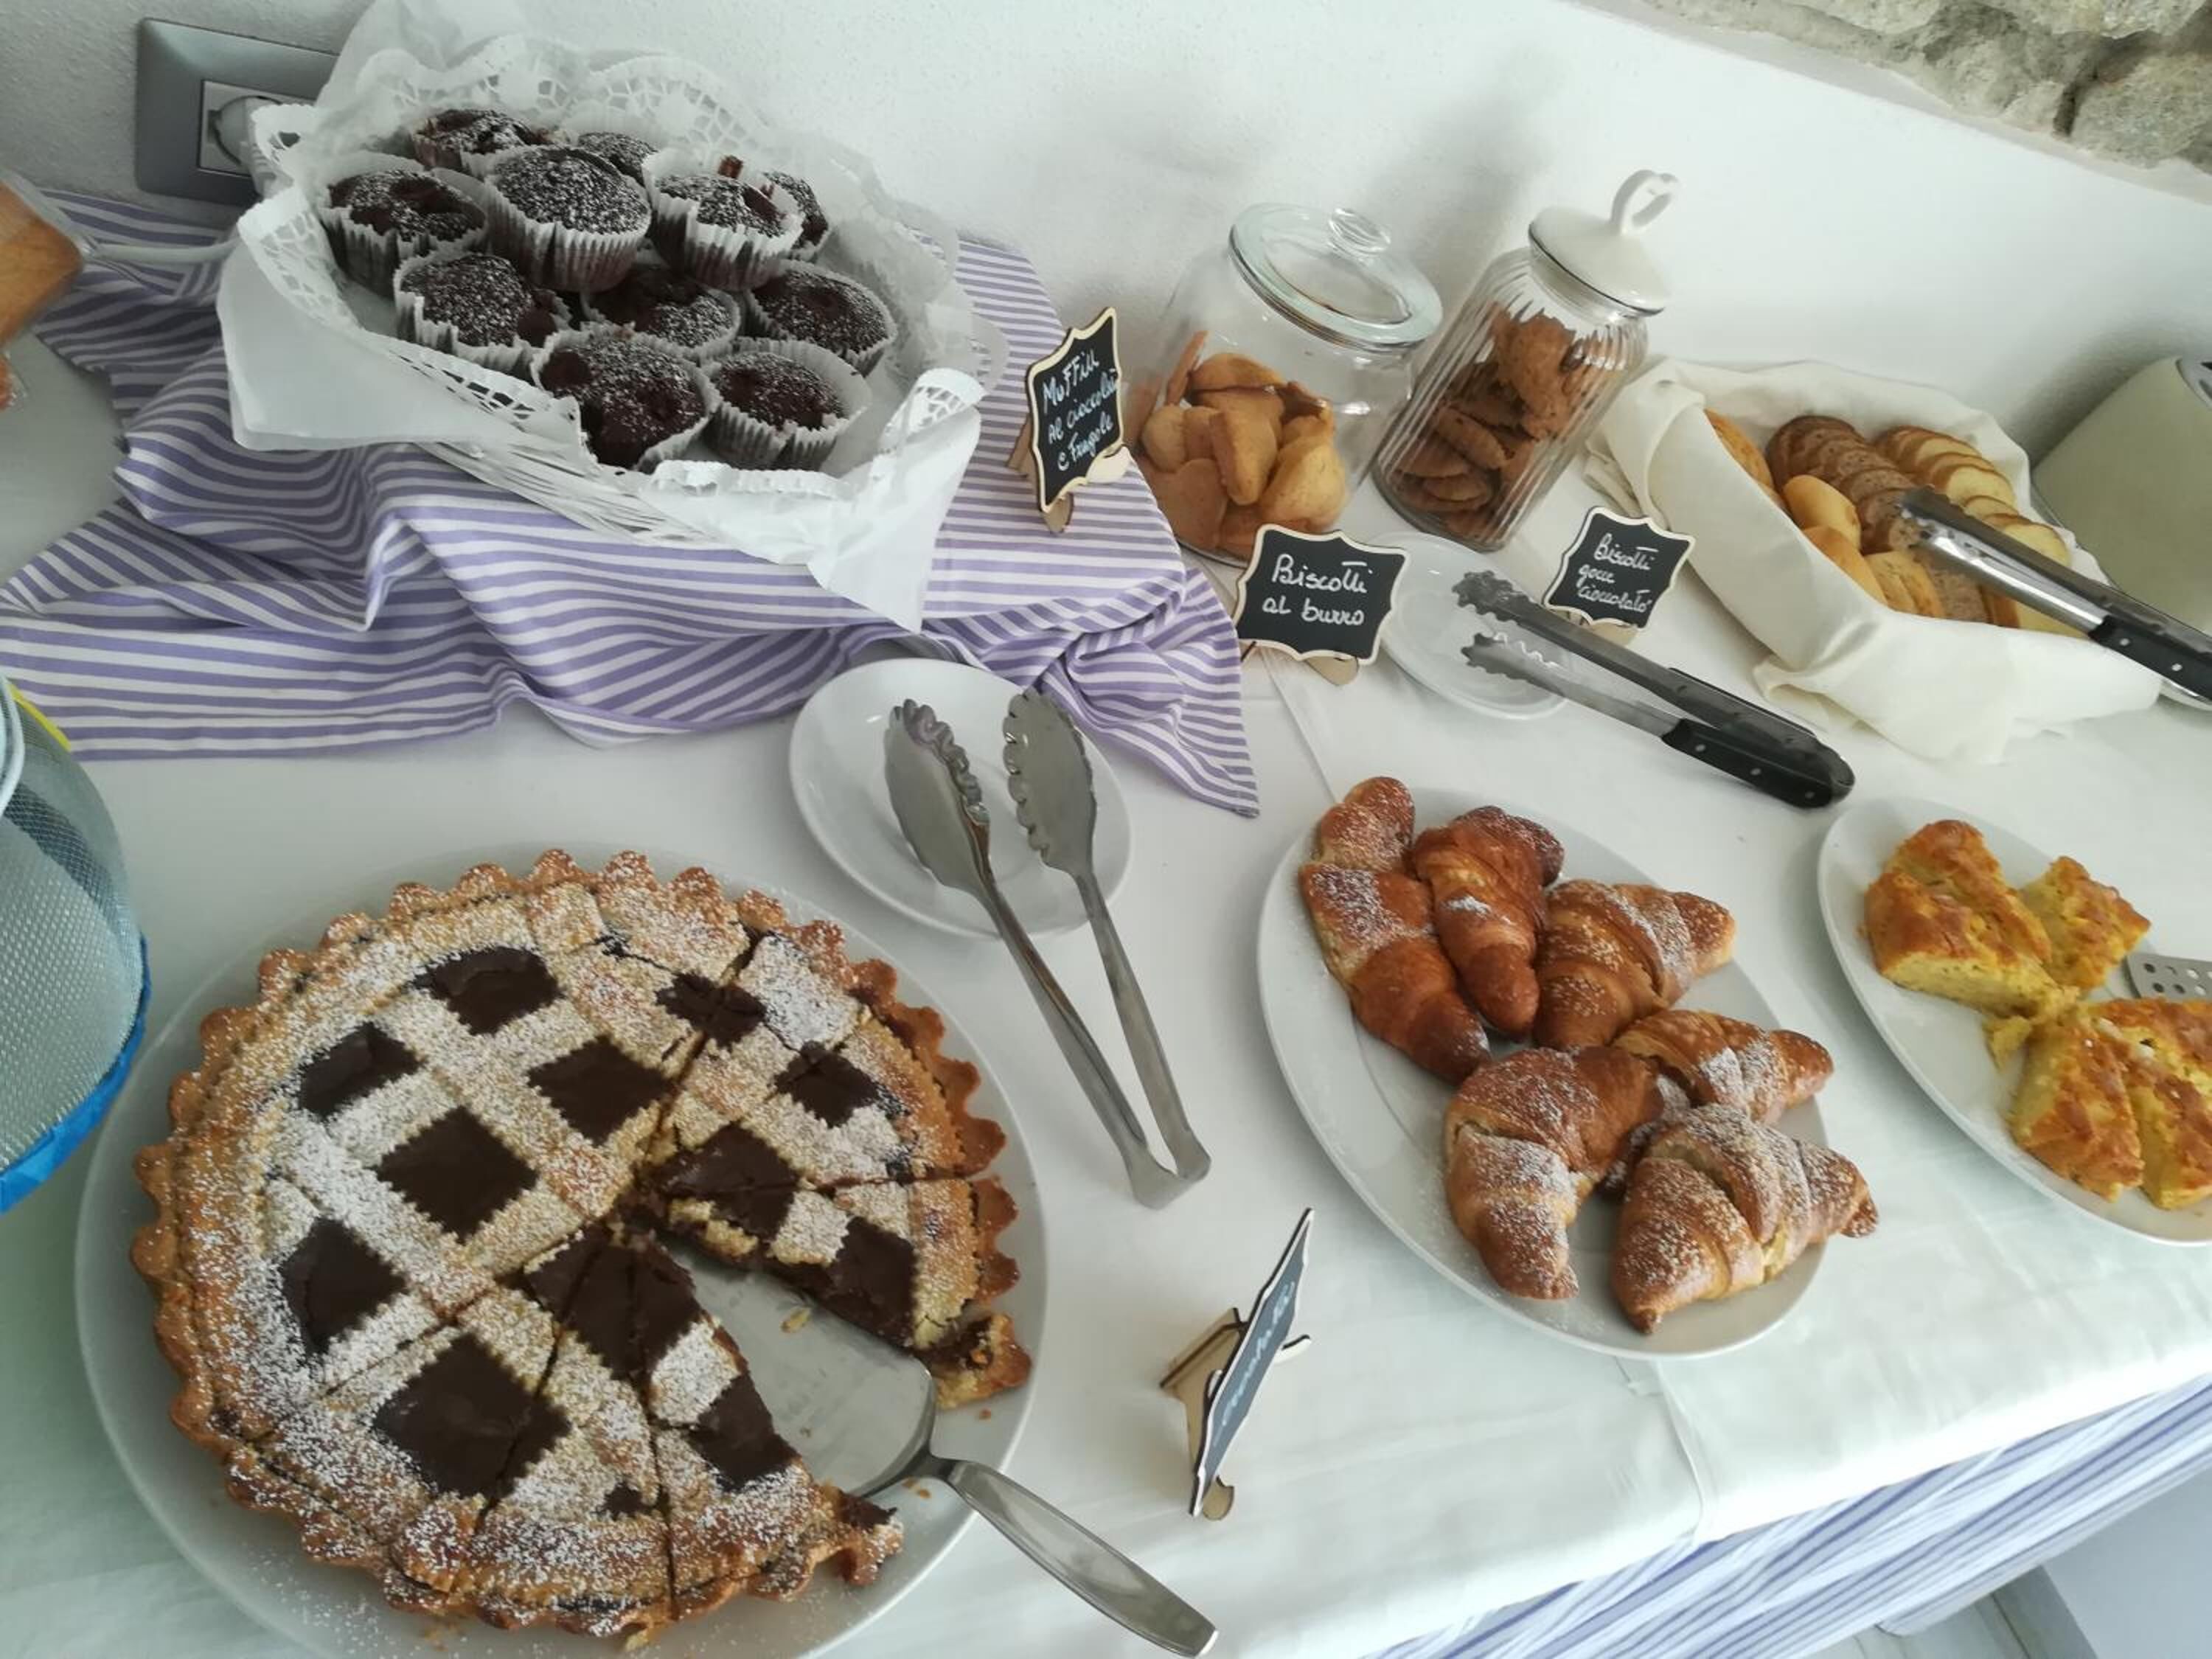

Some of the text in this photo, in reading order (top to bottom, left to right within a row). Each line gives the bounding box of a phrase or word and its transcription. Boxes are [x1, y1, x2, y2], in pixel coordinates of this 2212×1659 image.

[1594, 533, 1659, 571] Biscotti
[1271, 553, 1374, 594] Biscotti
[1301, 597, 1365, 626] burro
